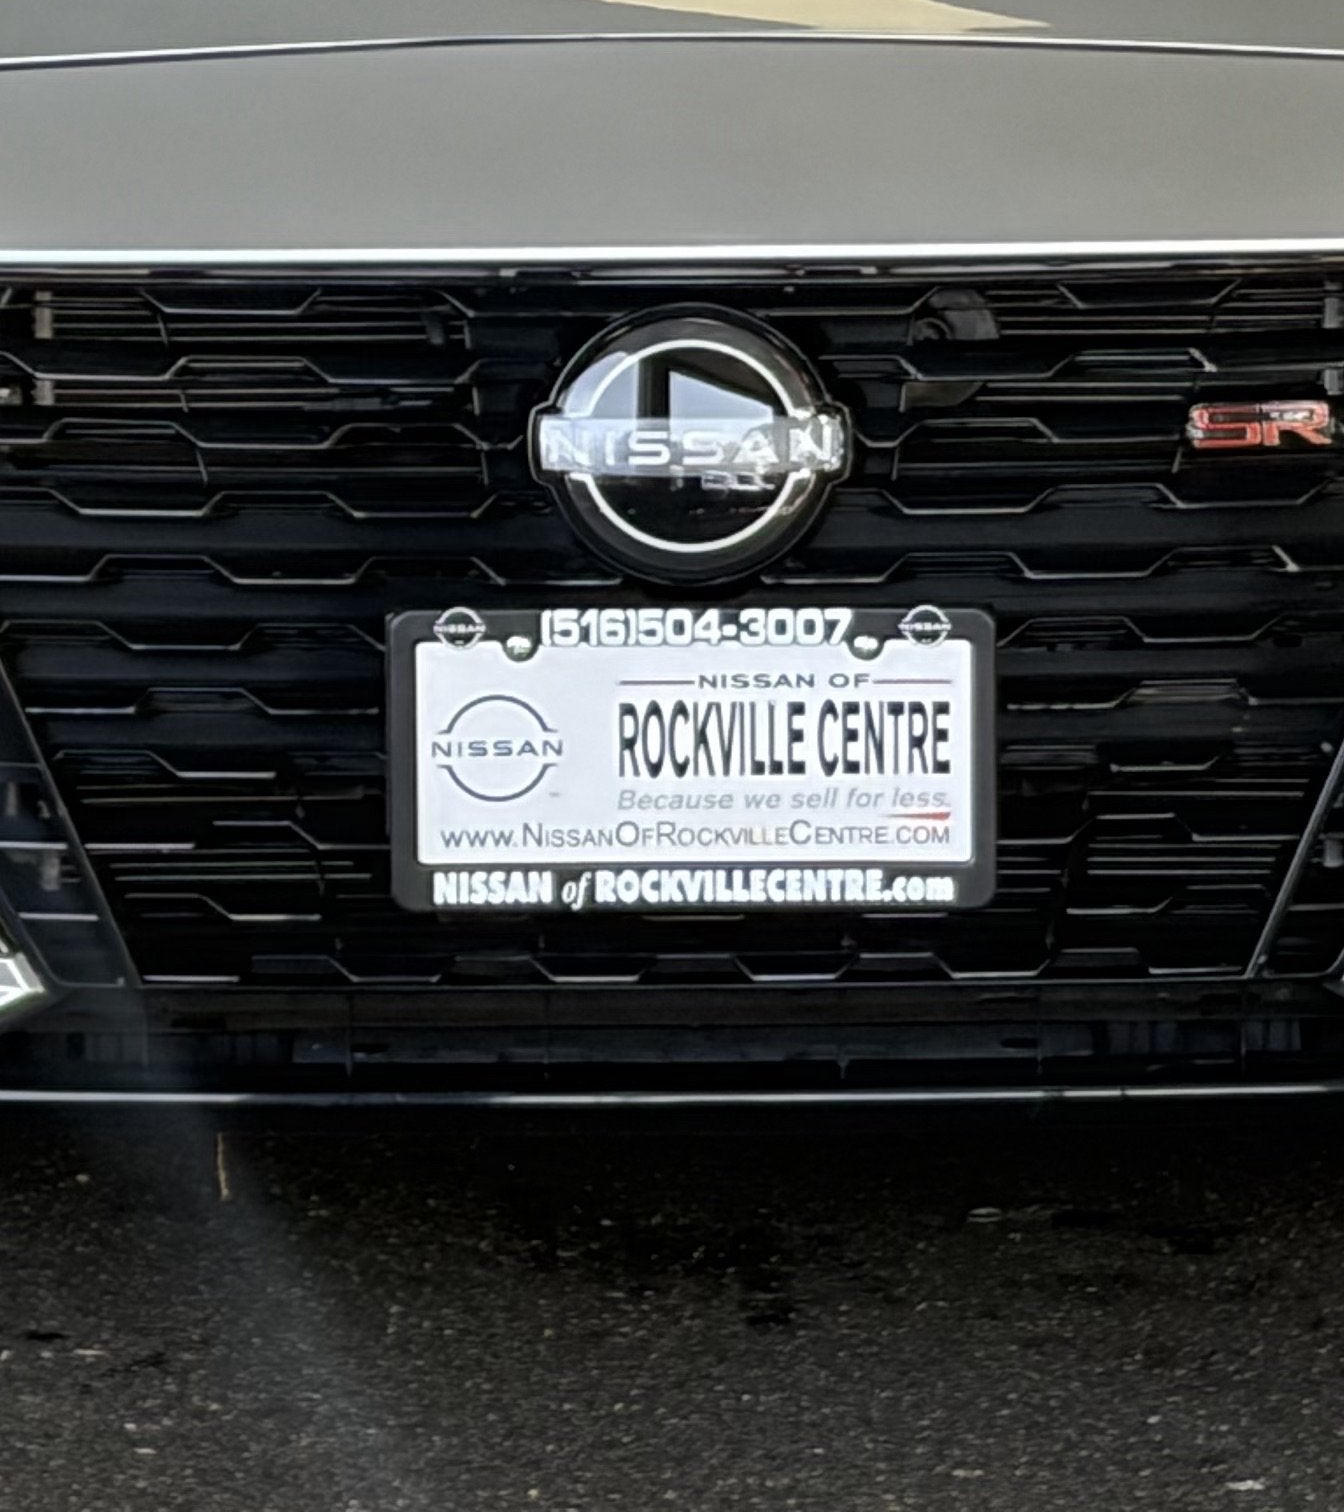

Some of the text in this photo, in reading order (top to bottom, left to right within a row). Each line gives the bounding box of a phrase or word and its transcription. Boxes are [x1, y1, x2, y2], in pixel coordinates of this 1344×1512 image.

[1188, 400, 1333, 449] SR
[544, 426, 833, 467] NISSAN
[698, 673, 871, 690] NISSAN OF
[431, 739, 564, 758] NISSAN
[618, 699, 952, 778] ROCKVILLE CENTRE
[617, 789, 734, 811] Because
[744, 793, 781, 811] we
[790, 787, 838, 810] sell
[846, 788, 885, 810] for
[432, 868, 955, 912] NISSAN of ROCKVILLECENTRE.com
